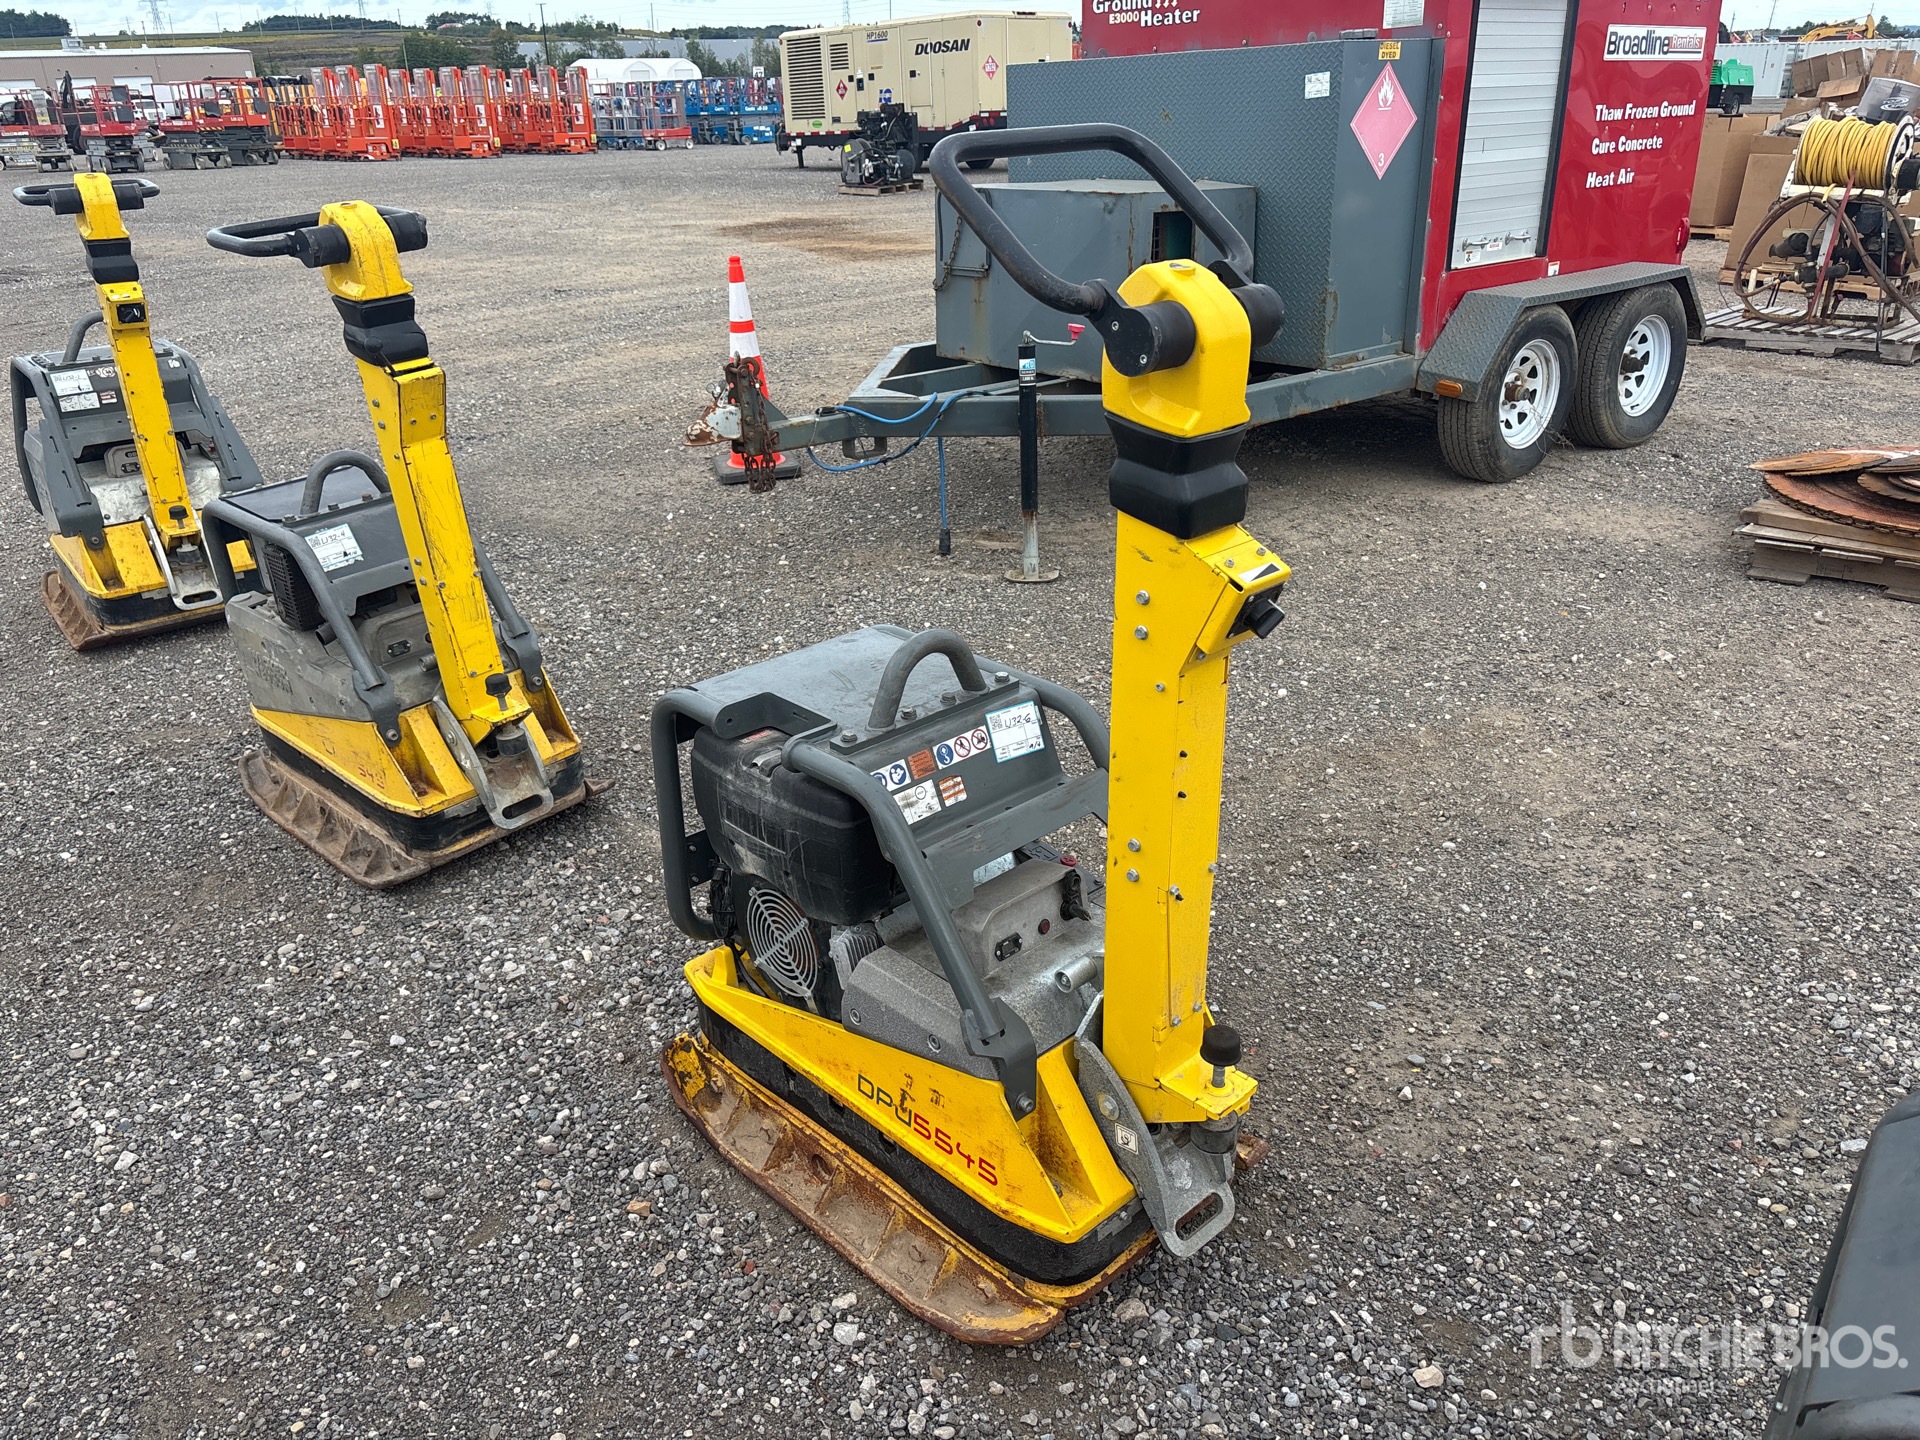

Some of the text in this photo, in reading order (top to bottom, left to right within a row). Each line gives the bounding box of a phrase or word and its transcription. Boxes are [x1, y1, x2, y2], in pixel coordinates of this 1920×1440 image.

[1109, 9, 1200, 27] E3000 Heater
[866, 31, 888, 39] HP1600
[1606, 29, 1700, 55] Broadline Rentals
[914, 38, 970, 55] DOOSAN
[1595, 99, 1696, 121] Thaw Frozen Ground
[1591, 135, 1662, 154] Cure Concrete
[1378, 152, 1385, 167] 3
[1585, 167, 1634, 188] Heat Air
